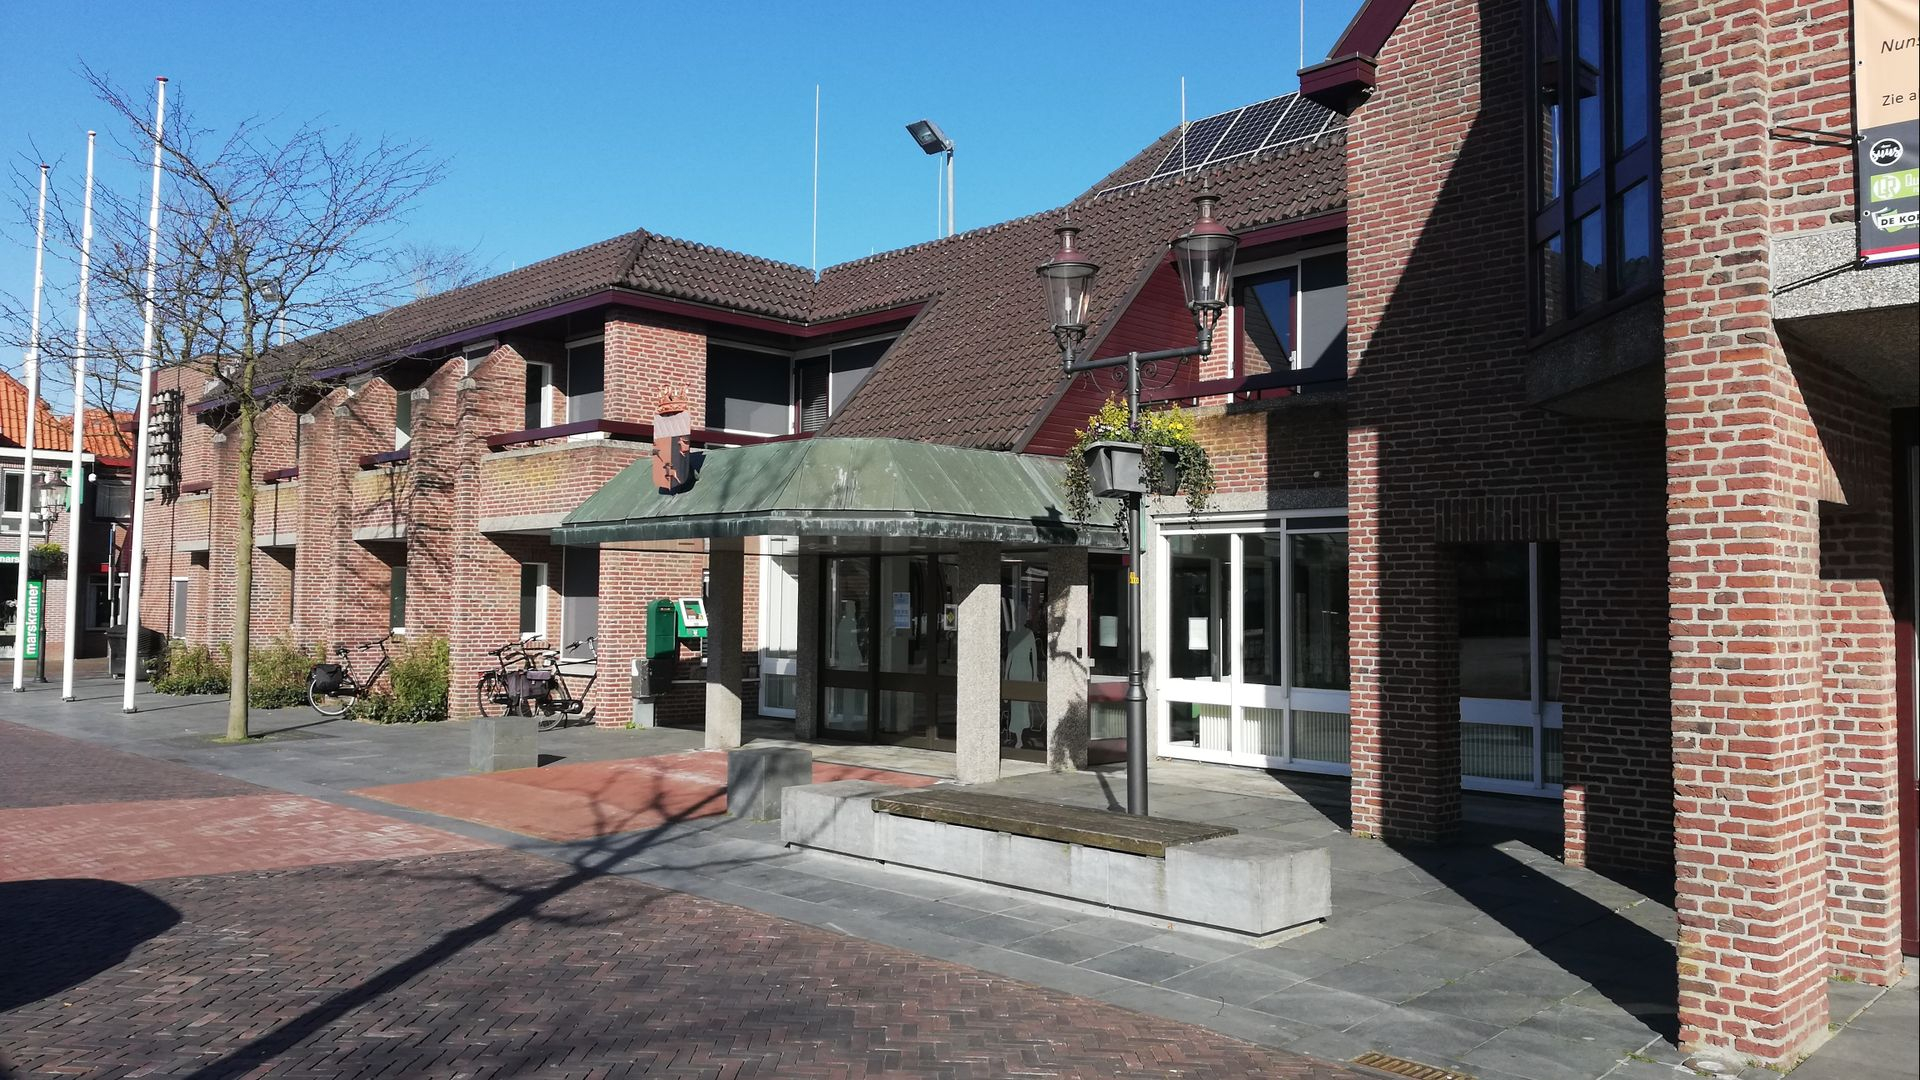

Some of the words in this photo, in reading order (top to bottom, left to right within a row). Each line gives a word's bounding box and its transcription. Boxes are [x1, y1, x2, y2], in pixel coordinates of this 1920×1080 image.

[1882, 94, 1904, 107] Zie
[1881, 217, 1895, 226] DE
[25, 583, 39, 655] marskramer
